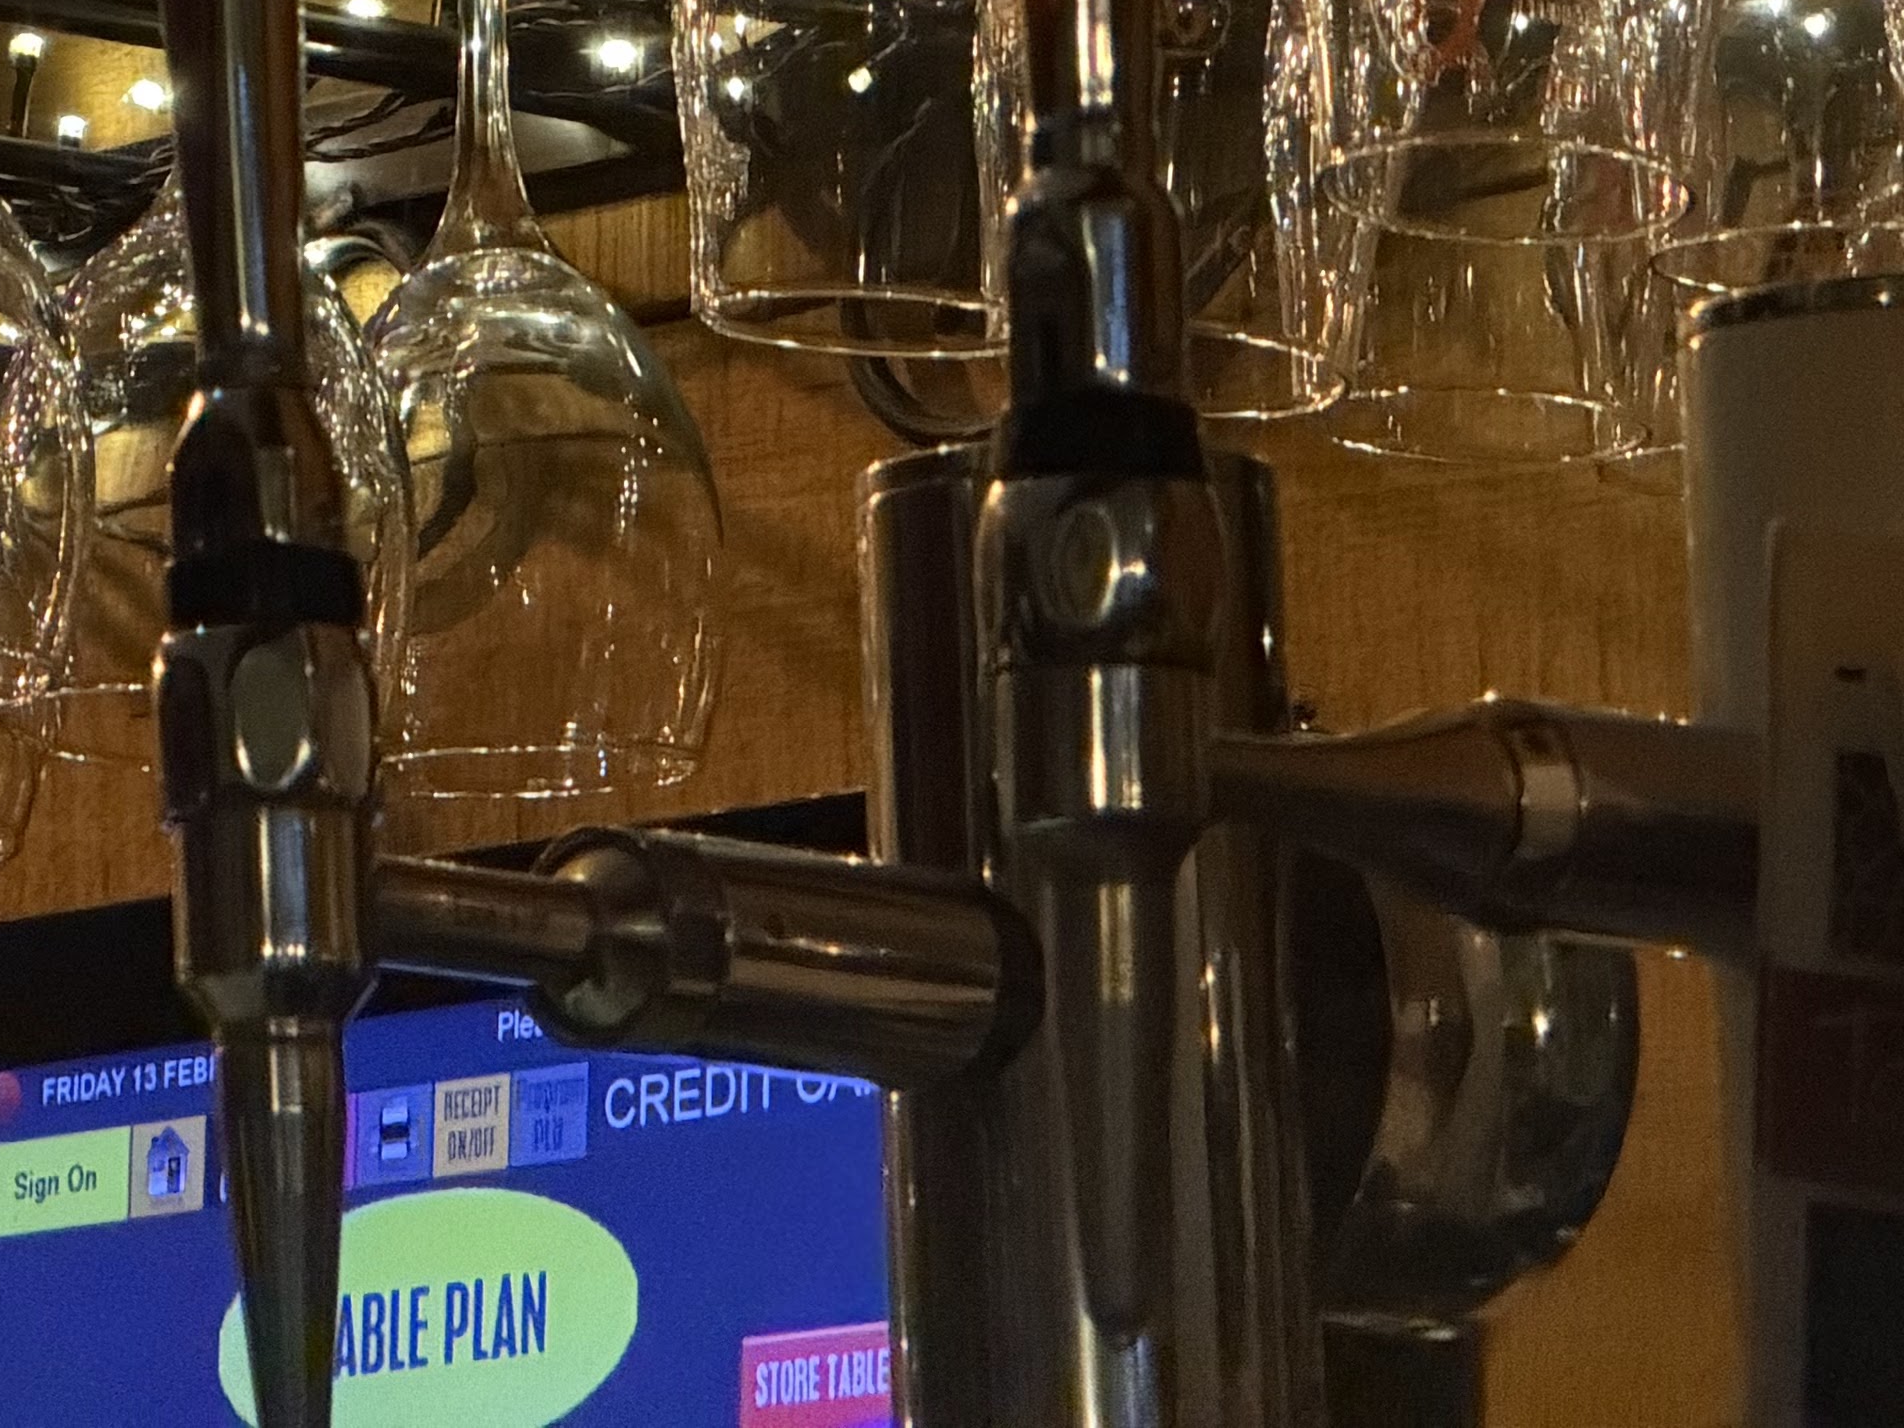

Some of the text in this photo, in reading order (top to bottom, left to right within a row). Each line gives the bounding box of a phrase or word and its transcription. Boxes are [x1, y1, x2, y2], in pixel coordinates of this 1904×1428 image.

[42, 1065, 126, 1106] FRIDAY
[132, 1062, 157, 1092] 13
[605, 1066, 771, 1128] CREDIT
[14, 1163, 97, 1204] Sign On
[332, 1270, 547, 1381] ABLE PLAN
[755, 1348, 890, 1408] STORE TABLE
